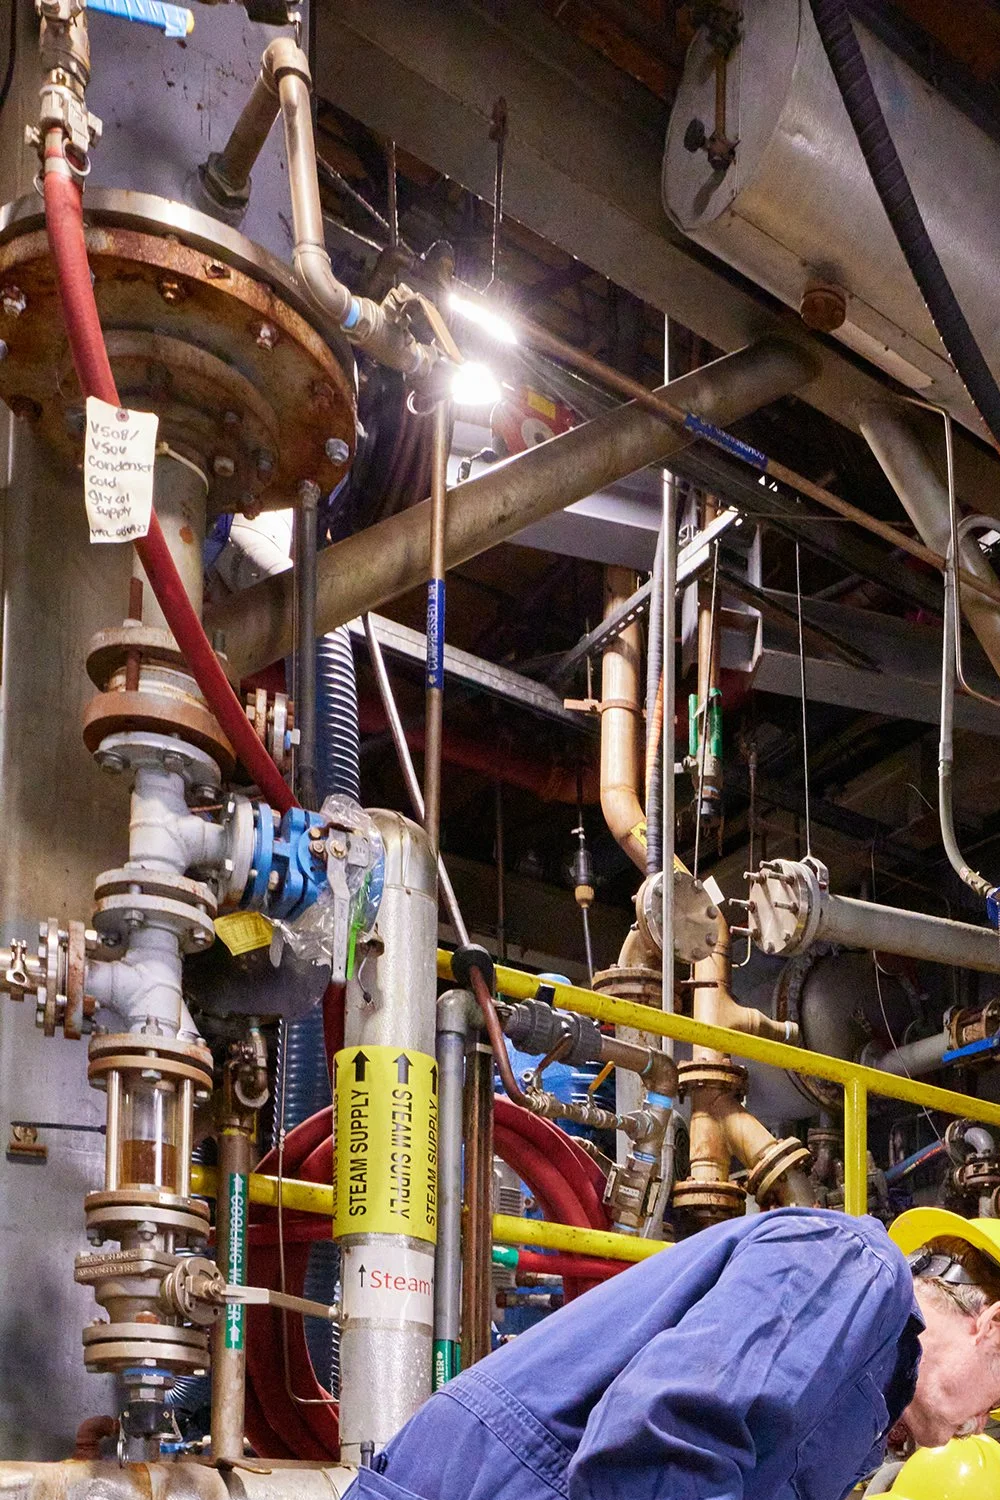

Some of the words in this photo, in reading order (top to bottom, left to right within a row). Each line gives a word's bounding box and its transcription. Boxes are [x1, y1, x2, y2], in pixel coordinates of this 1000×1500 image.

[427, 604, 438, 671] COMPRESSED
[350, 1090, 369, 1153] SUPPLY
[391, 1089, 413, 1149] STEAM
[427, 1099, 438, 1164] SUPPLY
[349, 1158, 368, 1216] STEAM
[390, 1152, 411, 1219] SUPPLY
[426, 1169, 437, 1226] STEAM
[230, 1194, 243, 1263] COOLING
[228, 1268, 242, 1321] WER
[370, 1270, 431, 1296] Steam
